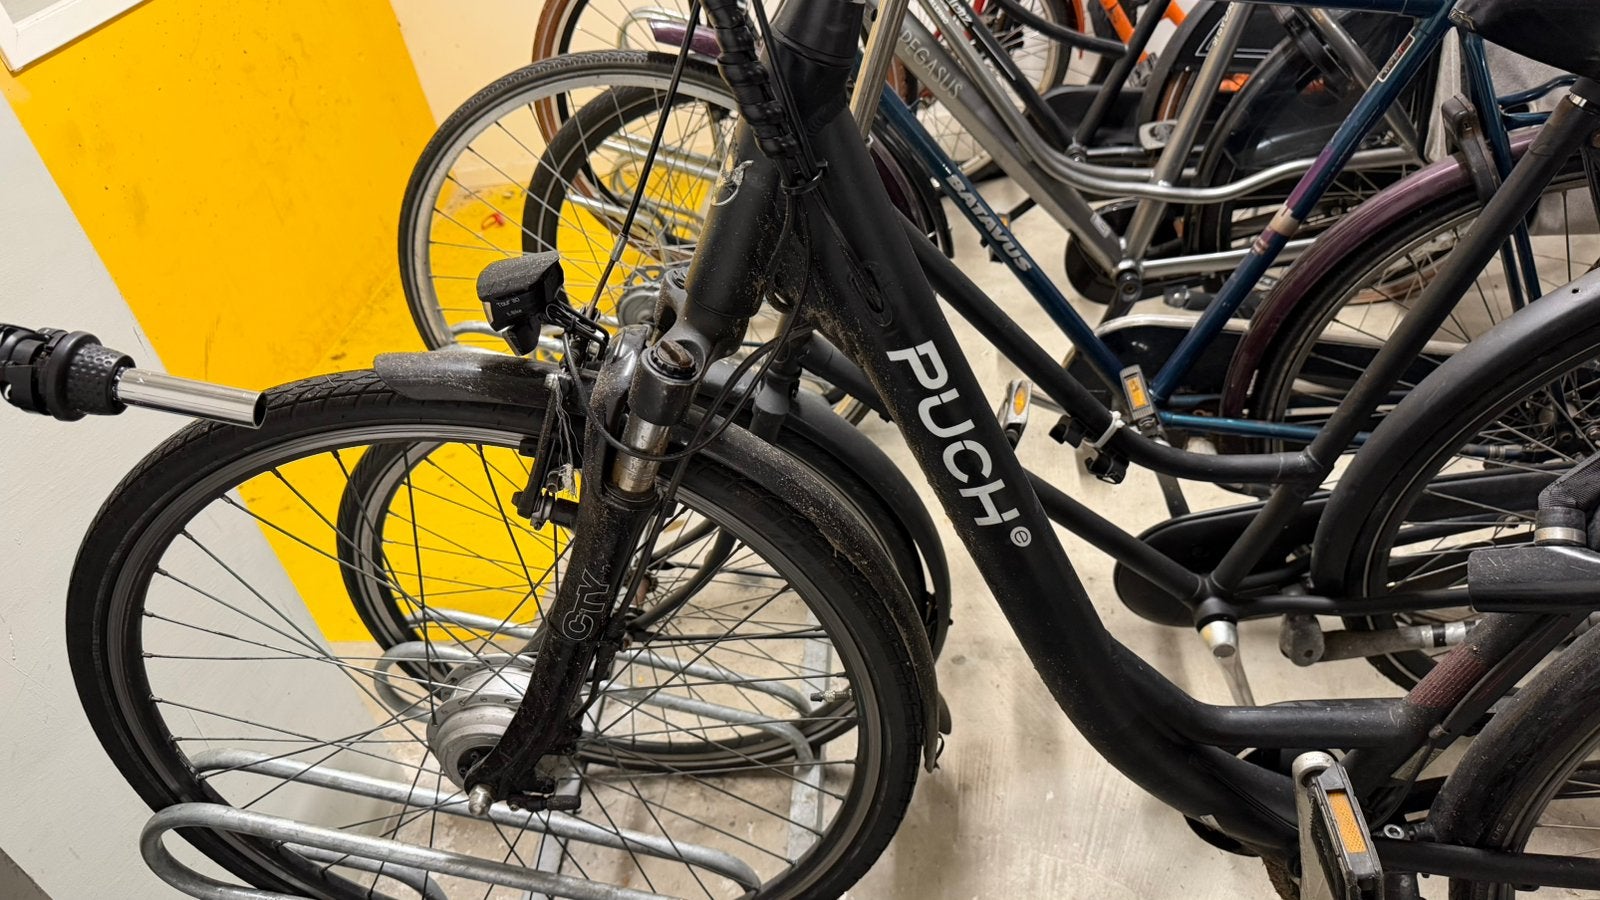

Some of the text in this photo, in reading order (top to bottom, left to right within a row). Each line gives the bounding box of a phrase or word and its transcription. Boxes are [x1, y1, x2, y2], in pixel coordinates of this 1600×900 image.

[899, 30, 962, 98] PEGASUS
[946, 174, 1032, 272] BATAVUS
[886, 340, 1020, 526] PUCH
